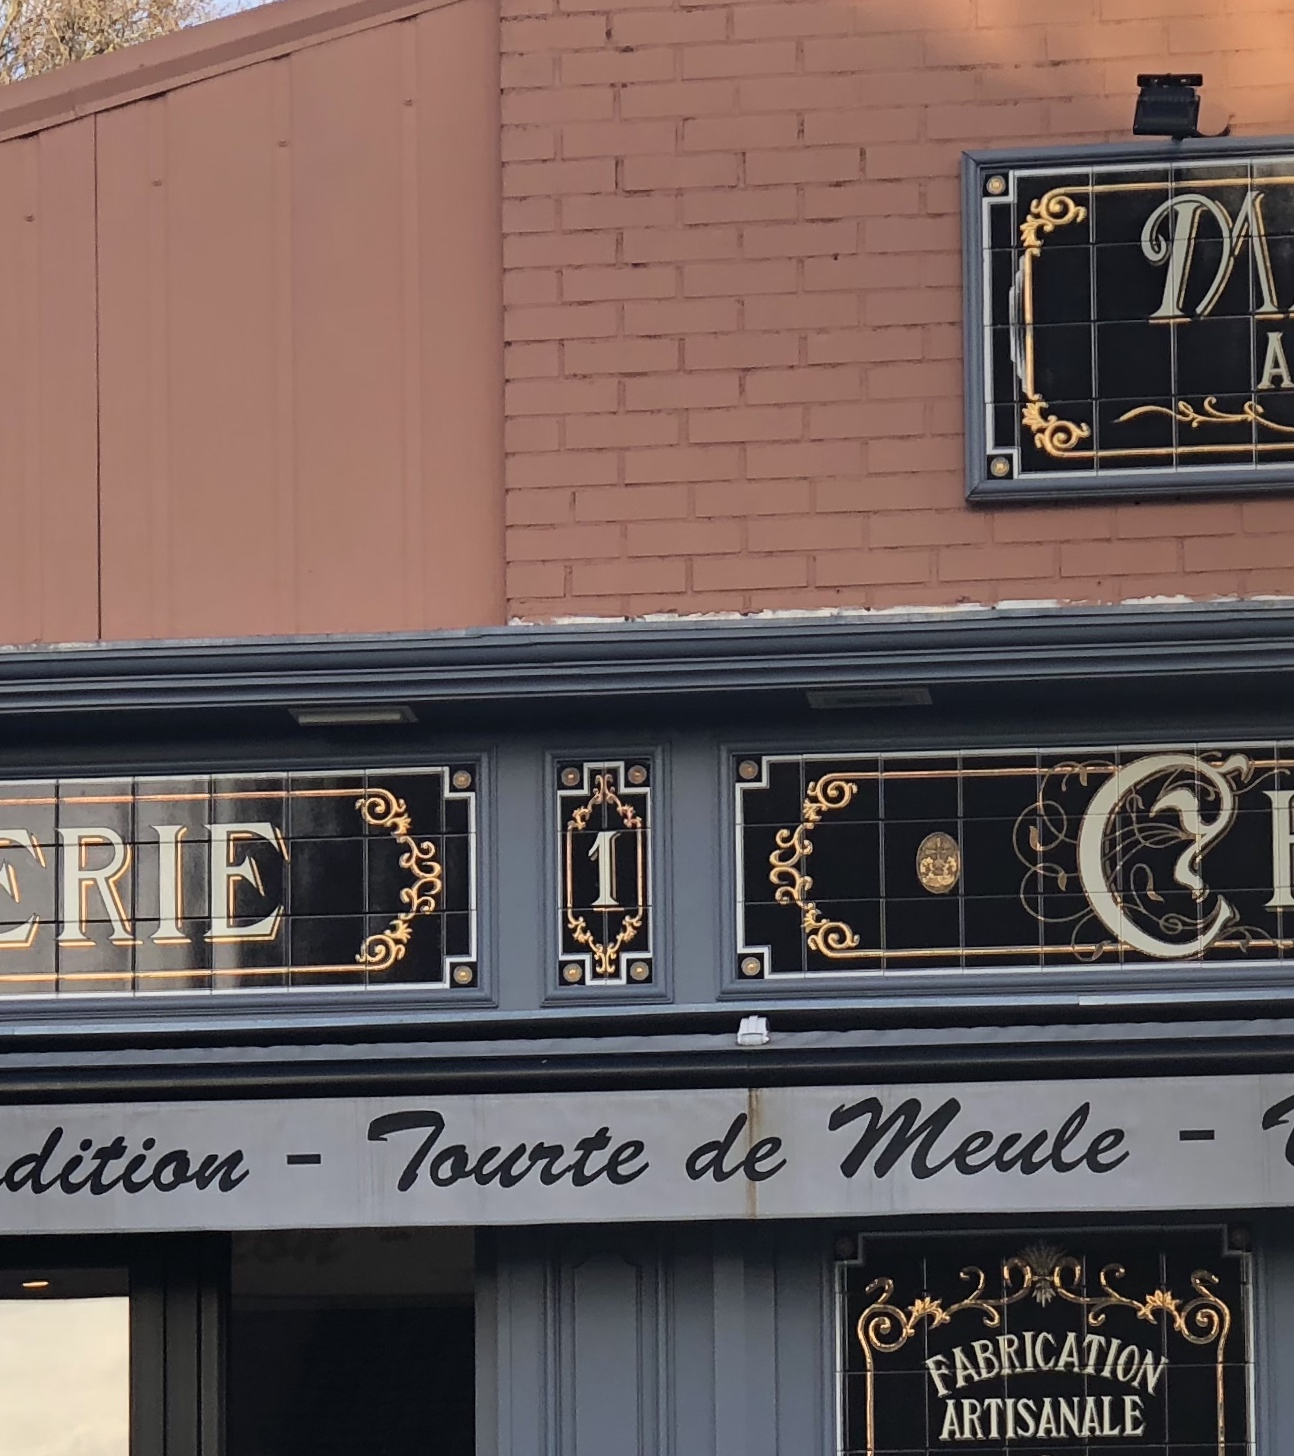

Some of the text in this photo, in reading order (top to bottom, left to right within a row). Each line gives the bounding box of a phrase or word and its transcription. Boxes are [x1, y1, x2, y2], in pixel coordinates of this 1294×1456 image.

[586, 828, 623, 910] 1
[368, 1111, 649, 1193] Tourte
[685, 1113, 788, 1182] de
[829, 1096, 1131, 1180] Meule
[925, 1331, 1169, 1398] FABRICATION
[939, 1395, 1146, 1441] ARTISANALE
